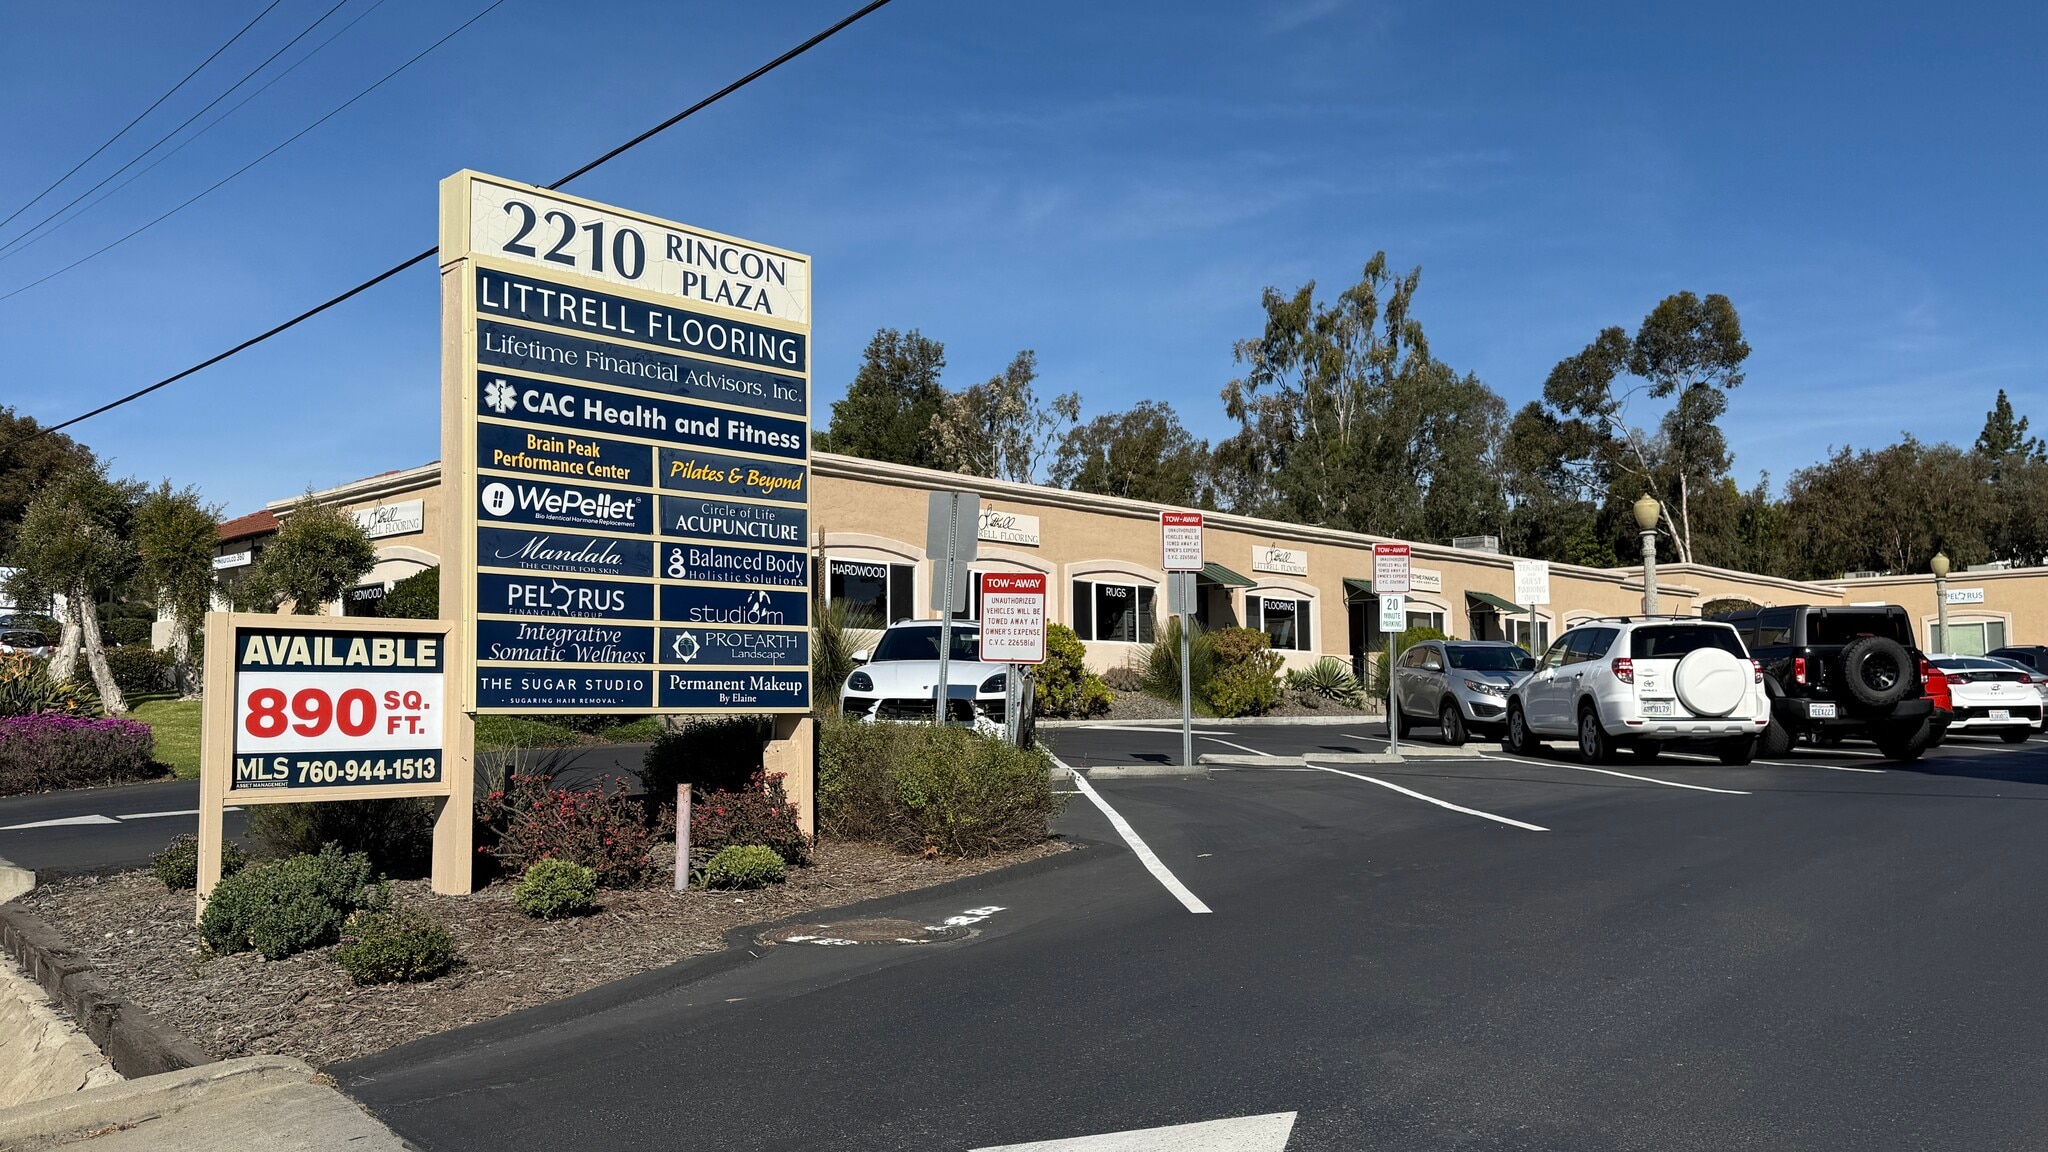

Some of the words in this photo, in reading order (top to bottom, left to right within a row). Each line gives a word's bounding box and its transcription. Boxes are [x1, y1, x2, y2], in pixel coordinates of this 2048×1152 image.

[502, 201, 647, 280] 2210
[666, 233, 786, 286] RINCON
[682, 270, 772, 315] PLAZA
[481, 277, 636, 335] LITTRELL
[649, 311, 797, 364] FLOORING
[485, 333, 578, 366] Lifetime
[585, 352, 678, 383] Financial
[685, 369, 767, 399] Advisors,
[773, 383, 802, 402] Inc.
[522, 390, 575, 418] CAC
[584, 398, 667, 431] Health
[675, 416, 719, 438] and
[728, 420, 801, 450] Fitness
[527, 434, 564, 455] Brain
[568, 441, 601, 458] Peak
[494, 450, 584, 476] Performance
[587, 460, 630, 481] Center
[670, 460, 724, 483] Pilates
[729, 468, 743, 483] &
[746, 470, 803, 494] Beyond
[546, 514, 571, 522] Identical
[572, 516, 598, 525] Hormone
[599, 518, 636, 528] Replacement
[701, 503, 736, 517] Circle
[740, 507, 751, 518] of
[755, 509, 775, 521] Life
[385, 518, 419, 533] FLOORING
[676, 515, 798, 541] ACUPUNCTURE
[979, 530, 997, 539] RELL
[1001, 532, 1038, 543] FLOORING
[519, 561, 539, 570] THE
[541, 563, 577, 572] CENTER
[579, 566, 597, 574] FOR
[599, 567, 619, 575] SKIN
[689, 548, 762, 571] Balanced
[766, 554, 804, 578] Body
[831, 563, 886, 578] HARDWOOD
[1518, 564, 1543, 572] TENANT
[689, 570, 741, 583] Holistic
[744, 573, 804, 586] Solutions
[987, 578, 1041, 588] TOW-AWAY
[1522, 577, 1541, 585] GUEST
[352, 588, 382, 600] RDWOOD
[991, 597, 1036, 605] UNAUTHORIZED
[1105, 587, 1126, 598] RUGS
[1524, 594, 1540, 602] ONLY
[509, 607, 562, 617] FINANCIAL
[570, 610, 603, 619] GROUP
[986, 607, 1014, 615] VEHICLES
[1264, 600, 1294, 611] FLOORING
[1387, 599, 1398, 610] 20
[516, 623, 622, 647] Integrative
[242, 635, 437, 667] AVAILABLE
[488, 642, 566, 661] Somatic
[570, 642, 646, 664] Wellness
[731, 648, 786, 666] Landscape
[481, 678, 512, 690] THE
[521, 678, 577, 691] SUGAR
[585, 679, 644, 691] STUDIO
[670, 675, 745, 691] Permanent
[750, 676, 803, 695] Makeup
[384, 690, 430, 711] SQ.
[719, 693, 729, 705] By
[732, 693, 757, 703] Elaine
[245, 688, 377, 738] 890
[387, 716, 425, 735] FT.
[236, 757, 289, 780] MLS
[297, 757, 436, 783] 760-944-1513
